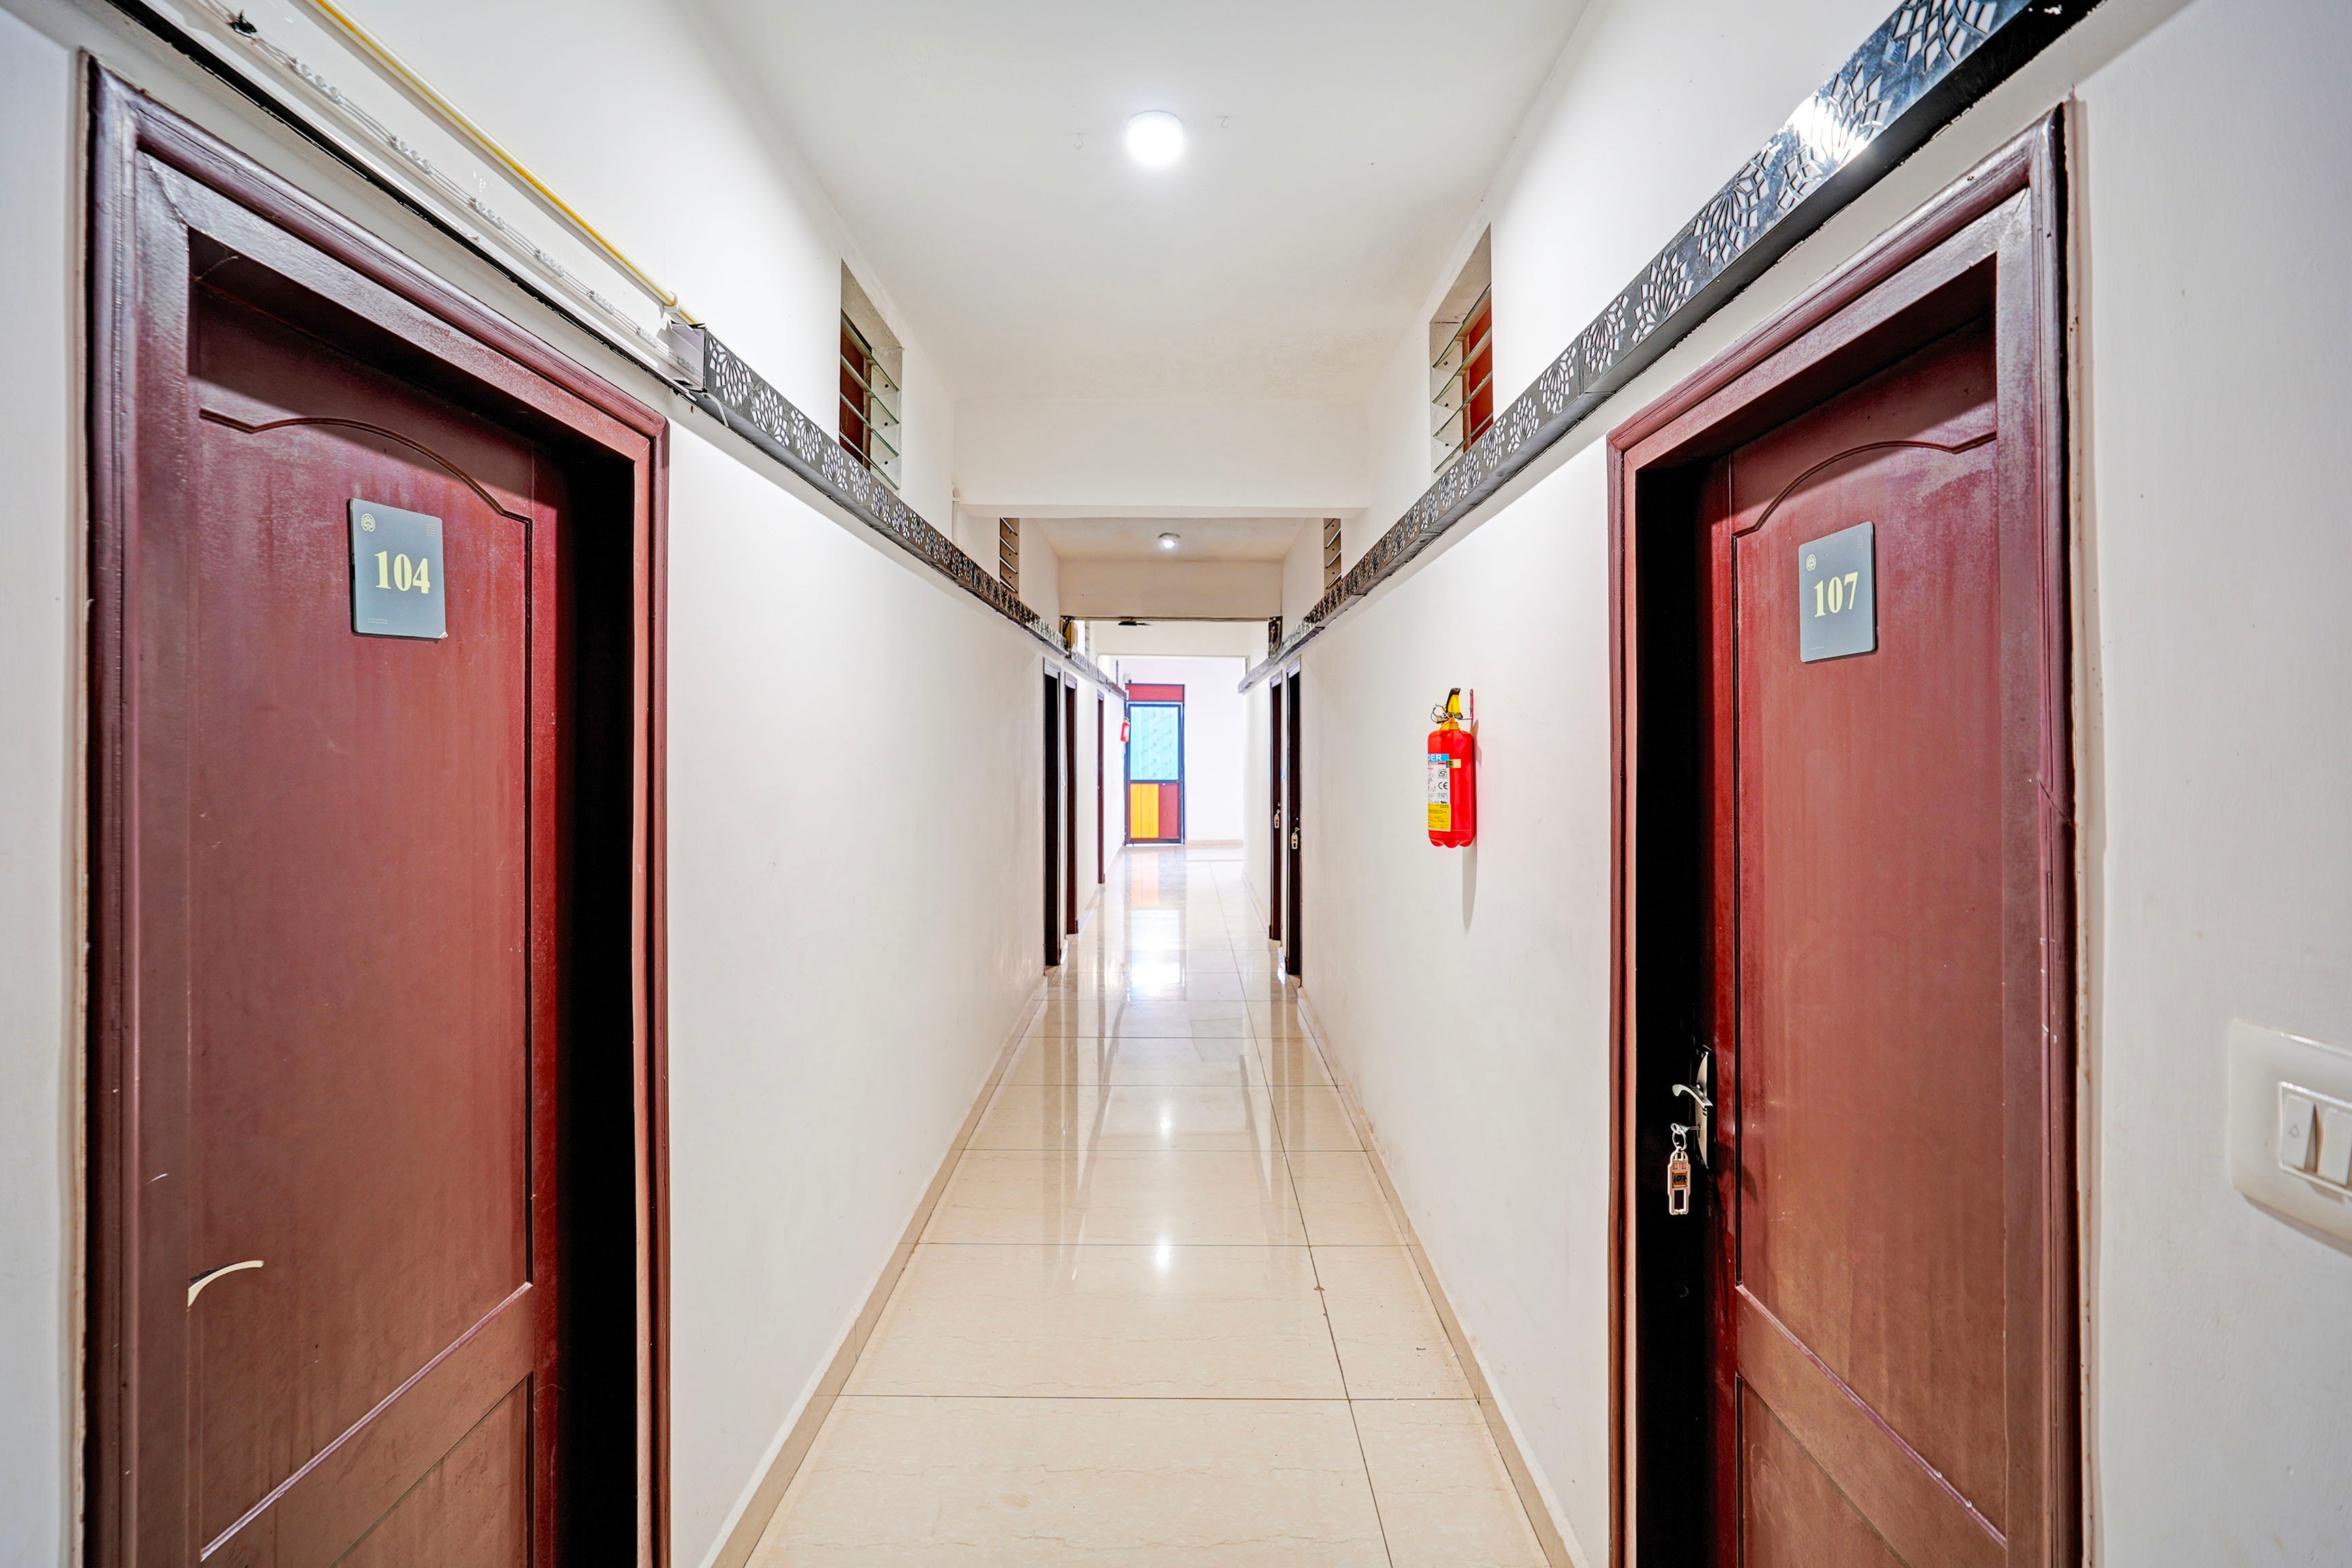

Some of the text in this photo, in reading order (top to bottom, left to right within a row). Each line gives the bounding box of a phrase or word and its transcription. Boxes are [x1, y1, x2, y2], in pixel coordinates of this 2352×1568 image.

[374, 551, 430, 594] 104
[1814, 572, 1859, 617] 107
[1673, 1175, 1687, 1183] 107
